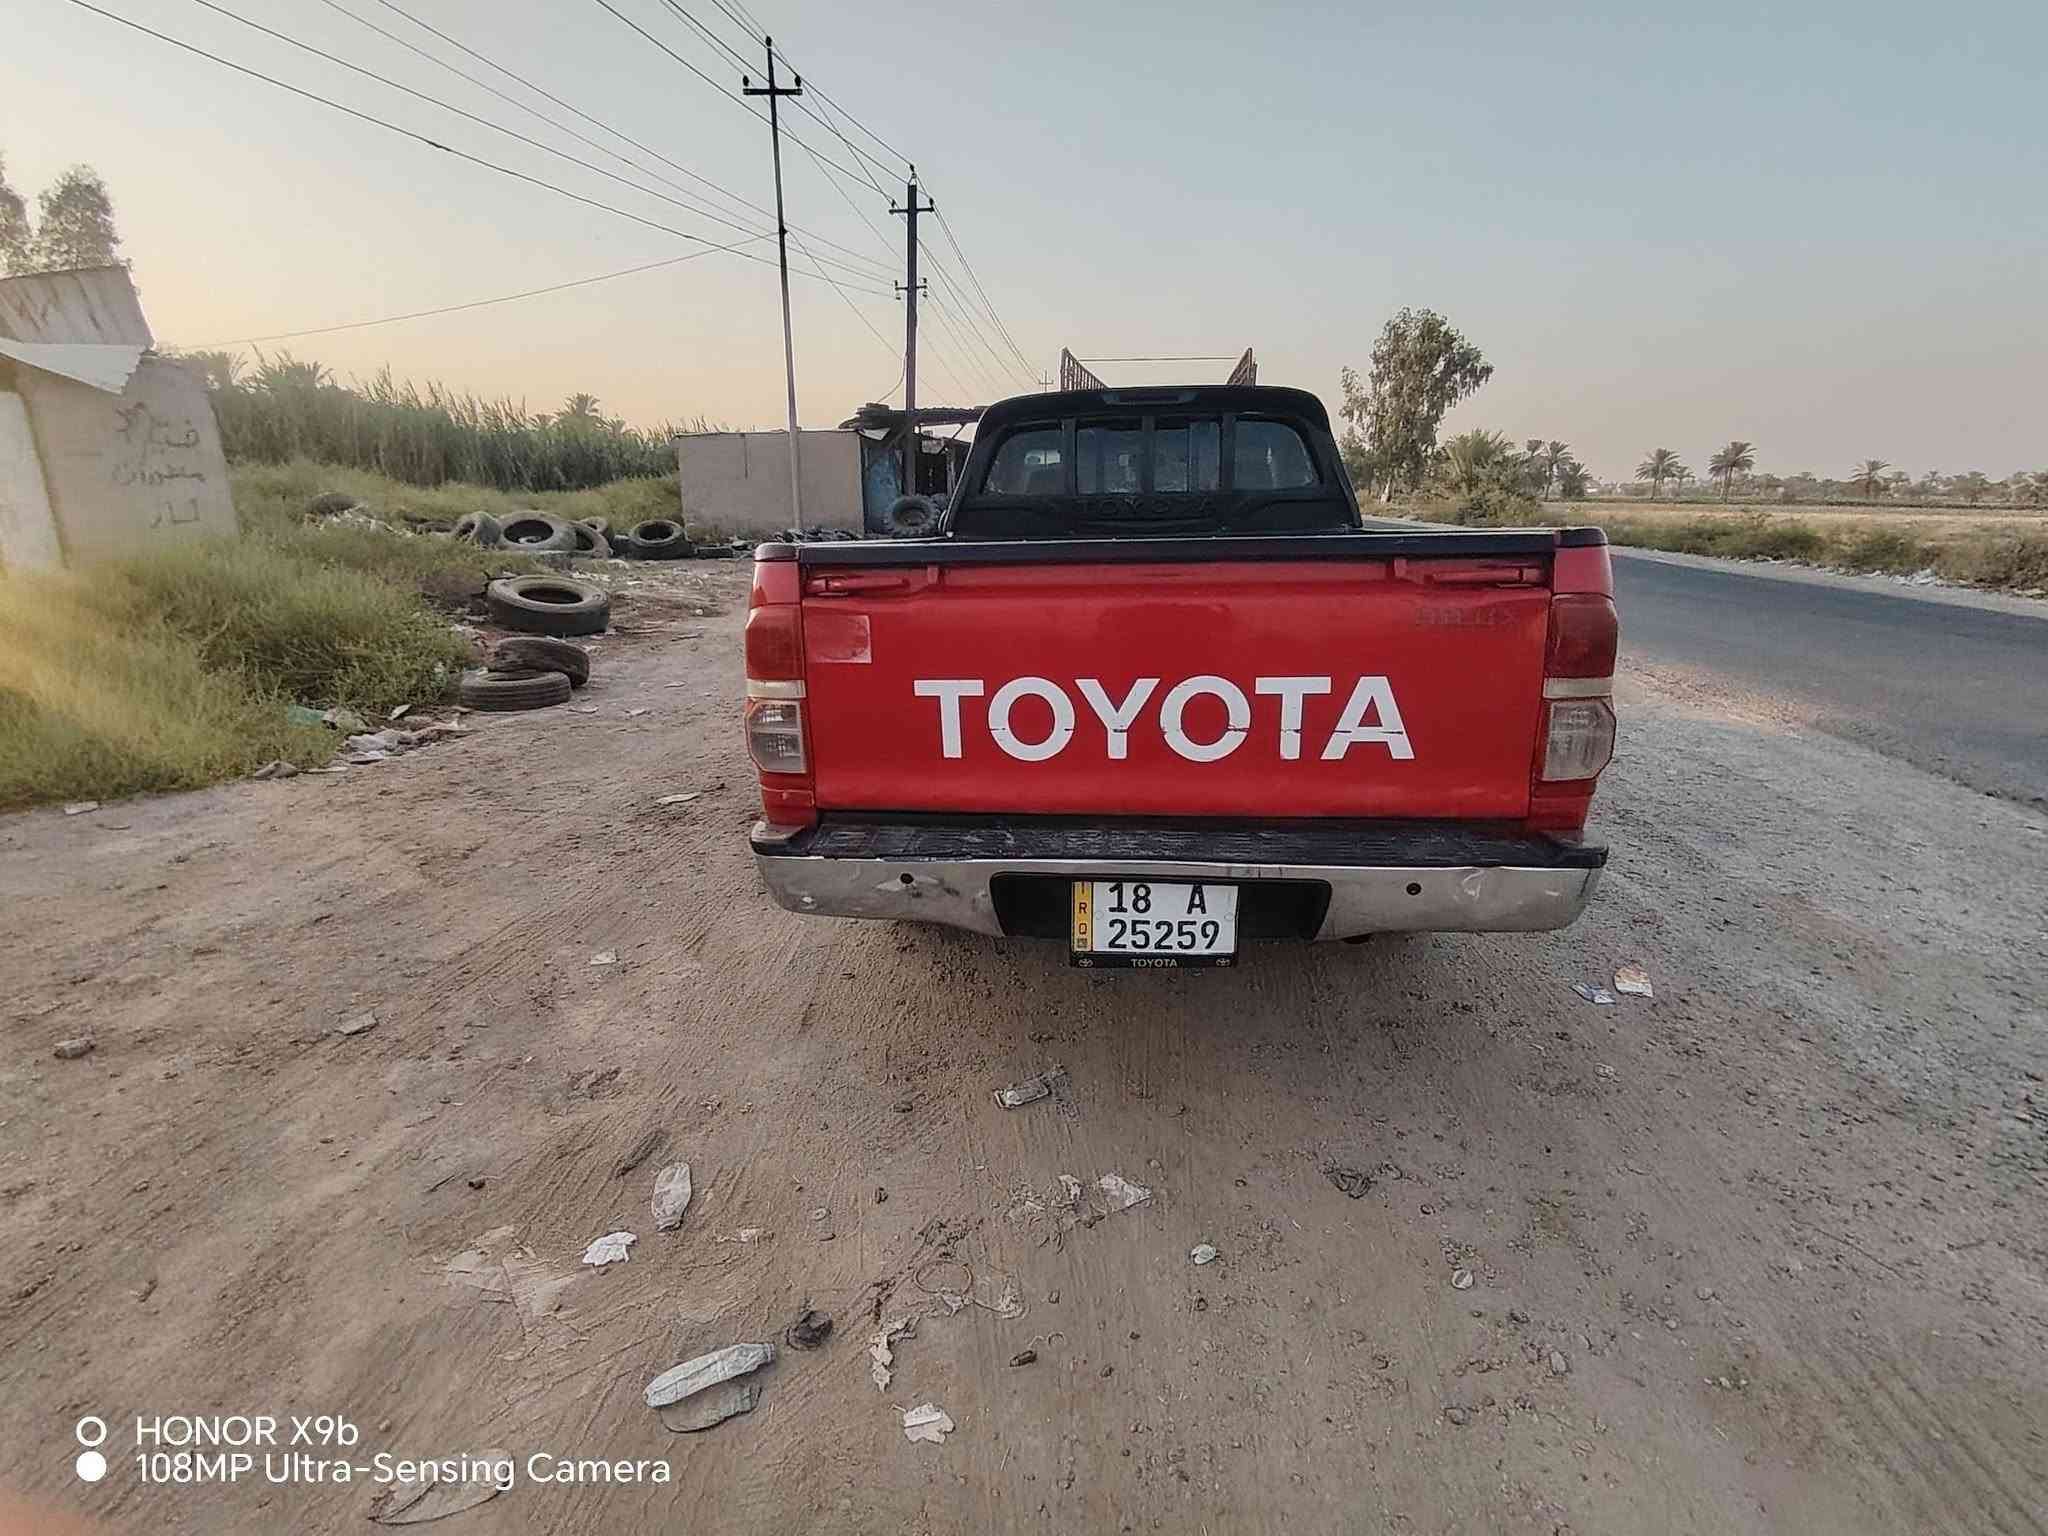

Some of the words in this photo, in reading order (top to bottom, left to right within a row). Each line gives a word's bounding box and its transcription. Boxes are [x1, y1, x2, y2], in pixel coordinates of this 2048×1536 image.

[913, 675, 1416, 763] TOYOTA
[1108, 882, 1152, 914] 18
[1186, 884, 1207, 915] A
[1107, 918, 1220, 950] 25259
[1130, 958, 1178, 968] TOYOTA
